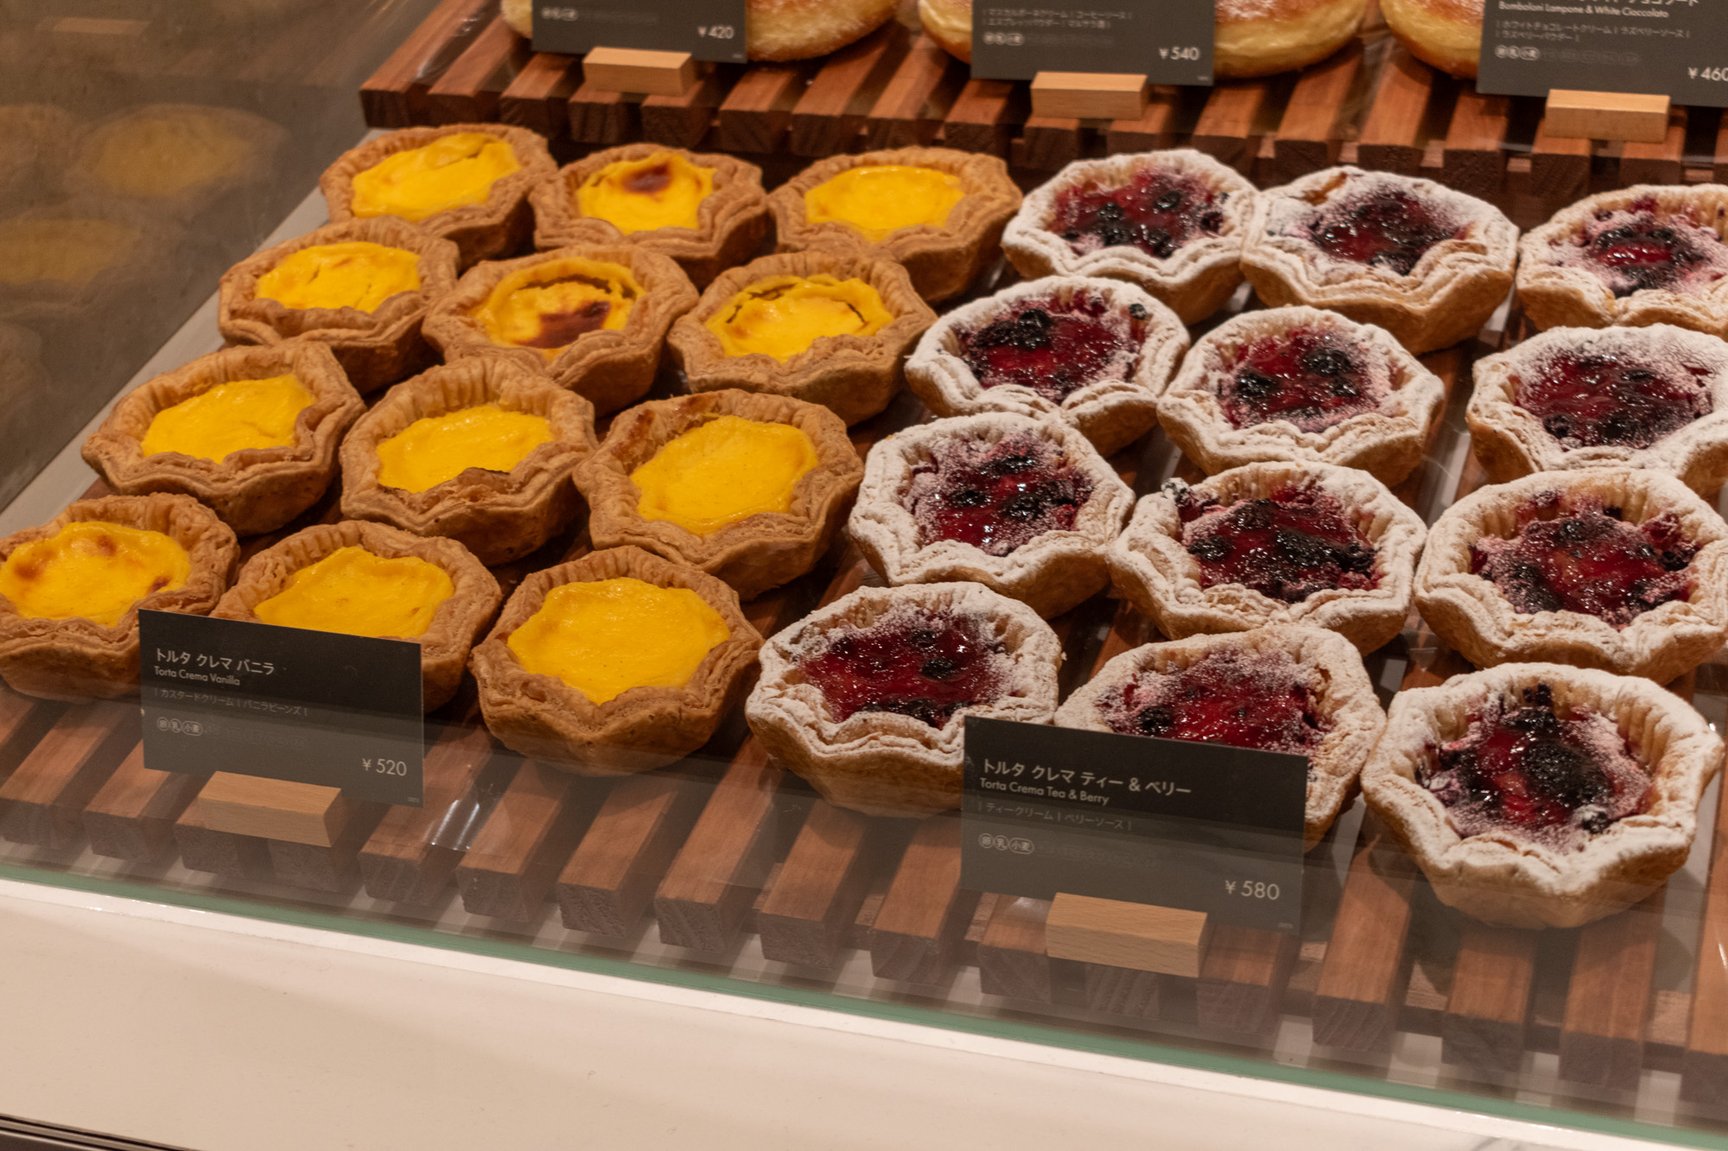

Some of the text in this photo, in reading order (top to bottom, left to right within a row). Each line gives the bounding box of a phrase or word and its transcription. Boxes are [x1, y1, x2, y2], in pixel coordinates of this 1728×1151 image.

[1586, 6, 1593, 14] &
[1594, 6, 1620, 16] White
[156, 648, 275, 675] トルタ クレマ バニラ
[154, 666, 240, 686] Torta Crema Vanilla
[984, 758, 1192, 796] トルタ クレマ ティー & ベリー
[980, 777, 1110, 806] Torta Crema Tea & Berry
